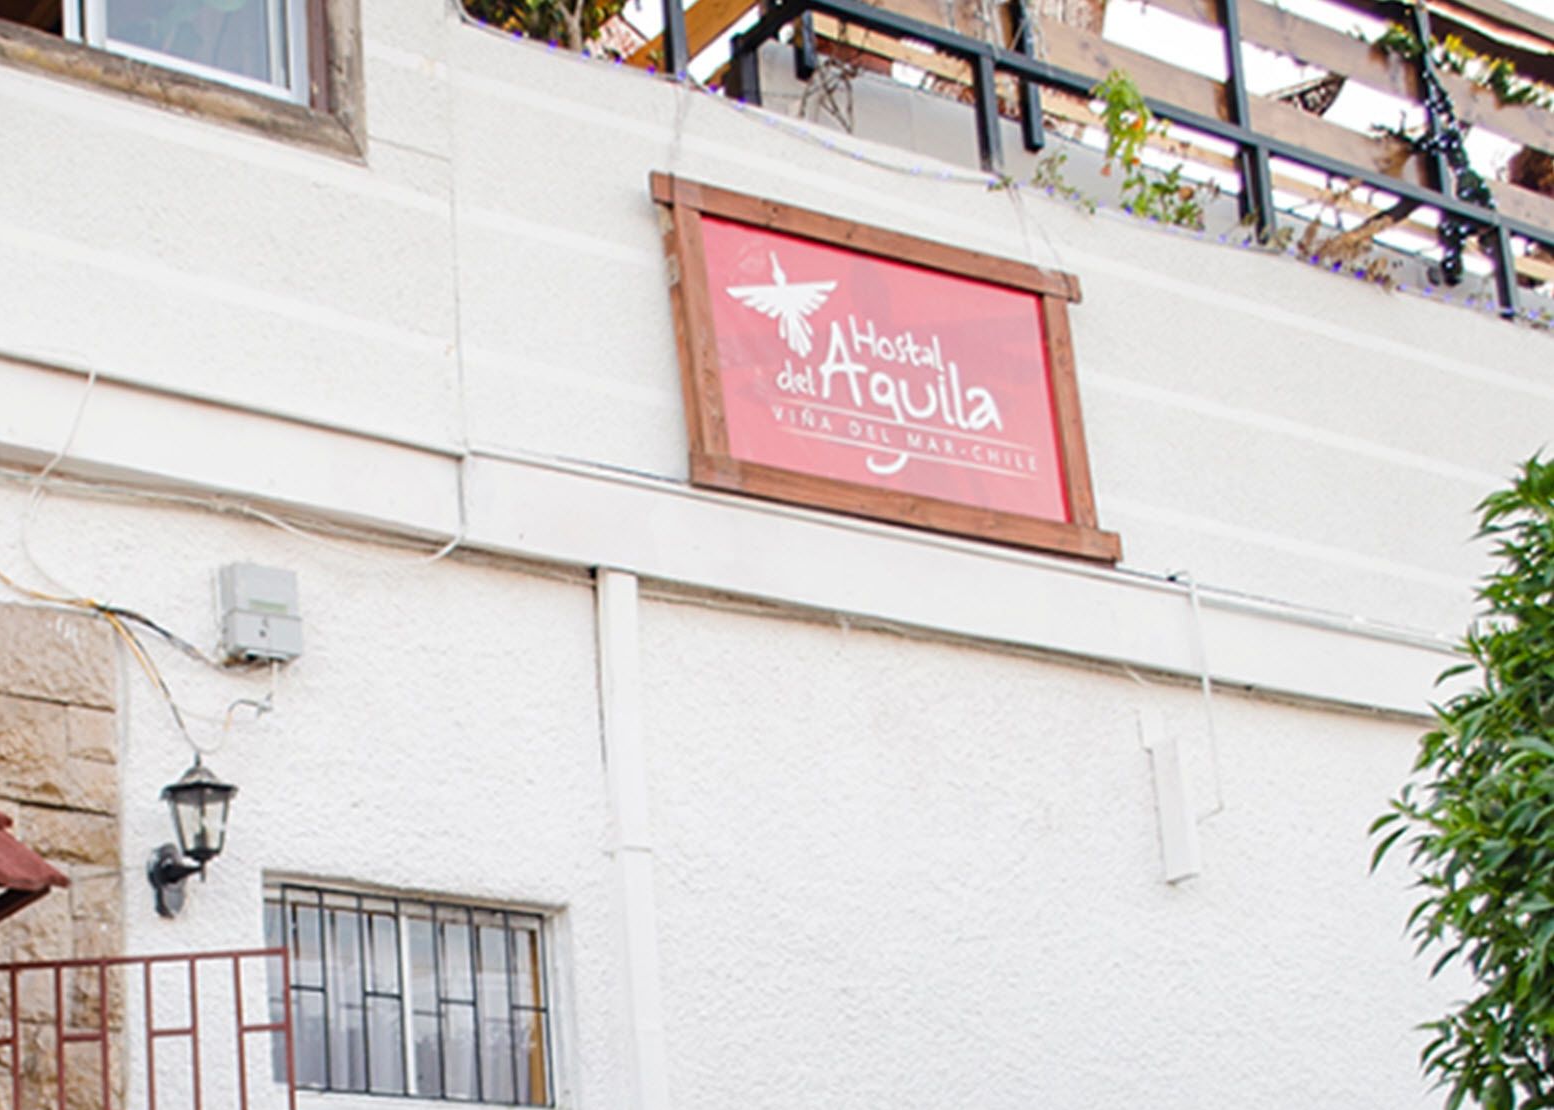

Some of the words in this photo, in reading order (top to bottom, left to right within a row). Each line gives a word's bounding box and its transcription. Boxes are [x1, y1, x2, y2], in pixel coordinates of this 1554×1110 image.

[847, 313, 945, 373] Hostal
[775, 358, 817, 397] del
[771, 403, 833, 432] VIÑA
[848, 419, 892, 444] DEL
